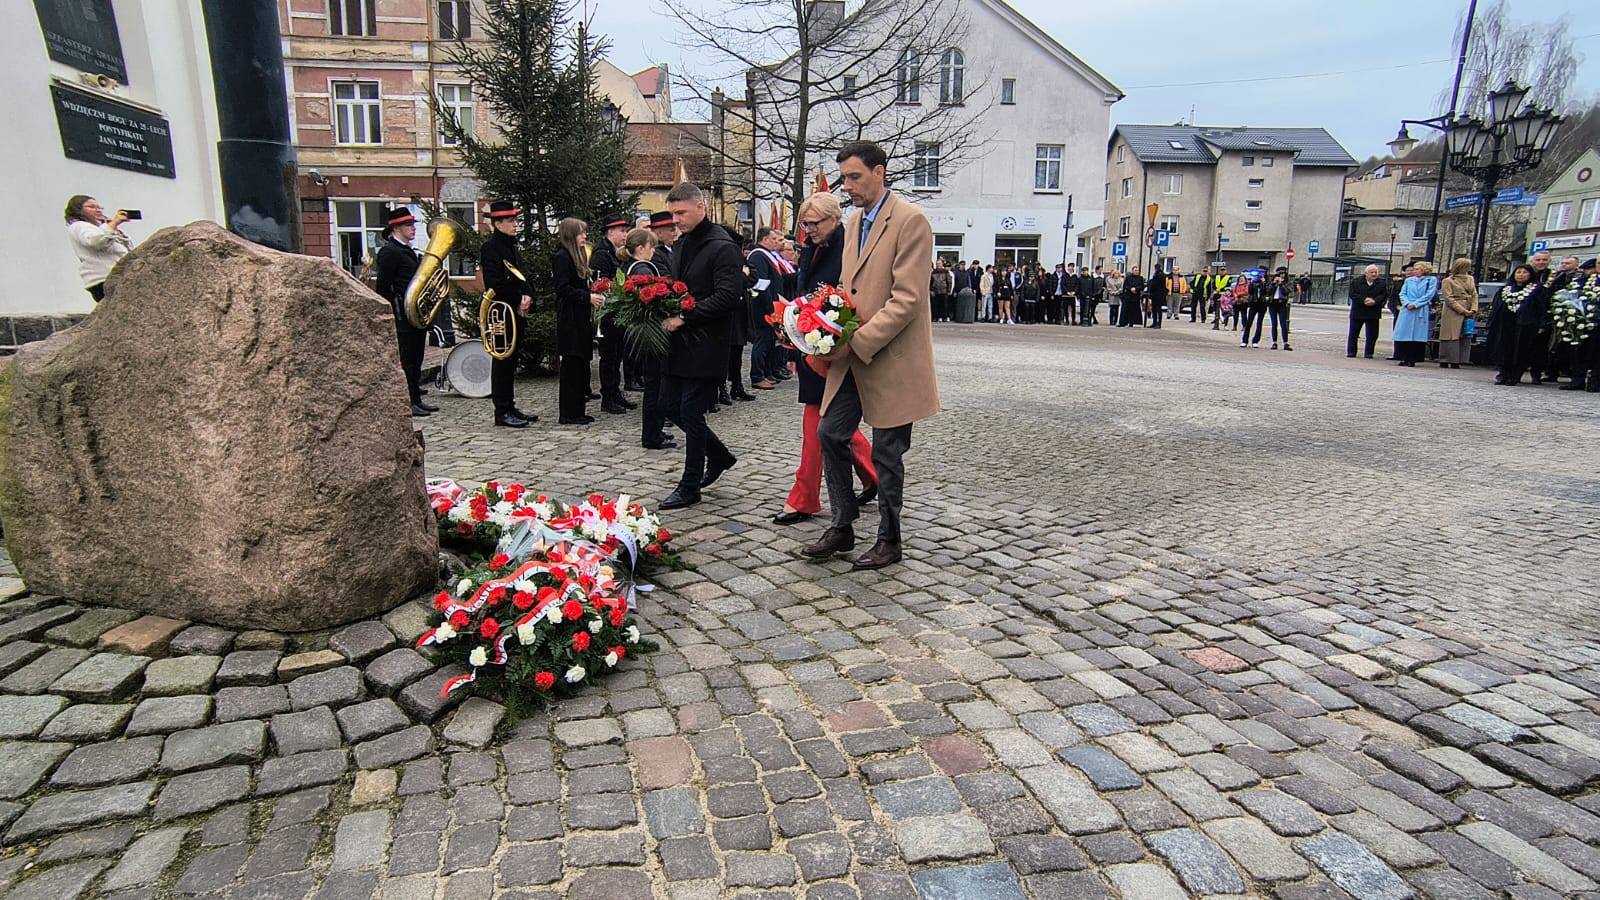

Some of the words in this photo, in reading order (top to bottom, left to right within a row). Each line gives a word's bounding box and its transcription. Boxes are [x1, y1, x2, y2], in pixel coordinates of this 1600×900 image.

[62, 100, 105, 119] WDZIĘCZNI
[107, 113, 126, 125] BOGU
[129, 119, 138, 128] ZA
[98, 123, 144, 141] PONTYFIKATU
[99, 135, 117, 147] JANA
[119, 140, 141, 153] PAWŁA
[1157, 231, 1167, 245] P
[1115, 243, 1124, 255] P
[1533, 242, 1544, 252] P
